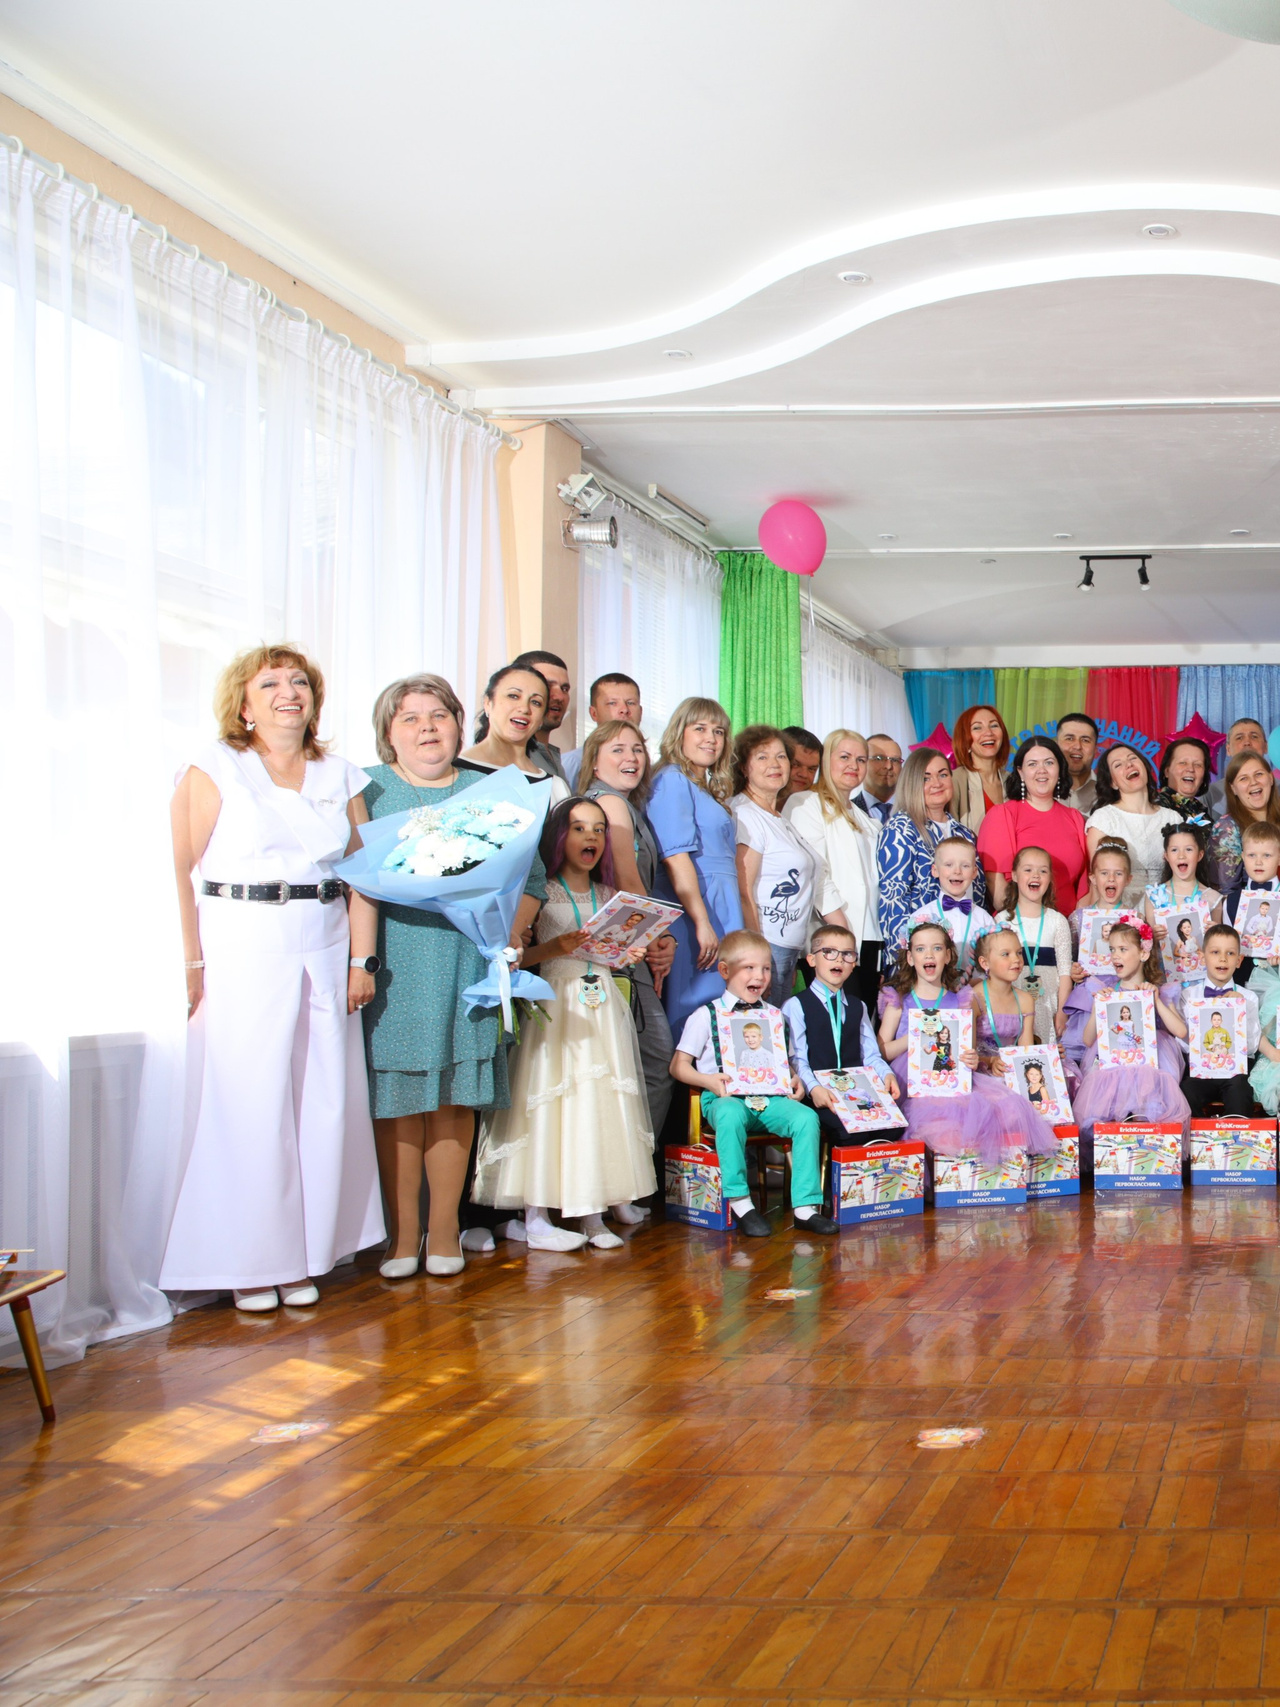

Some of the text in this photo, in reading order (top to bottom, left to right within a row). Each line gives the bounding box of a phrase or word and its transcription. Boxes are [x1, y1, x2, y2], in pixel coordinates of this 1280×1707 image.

[1119, 1126, 1154, 1134] ErichKrause
[1215, 1122, 1249, 1130] ErichKrause
[866, 1150, 899, 1158] ErichKrause
[957, 1196, 1006, 1204] ПЕРВОКЛАССНИКА
[860, 1208, 904, 1219] ПЕРВОКЛАССНИКА
